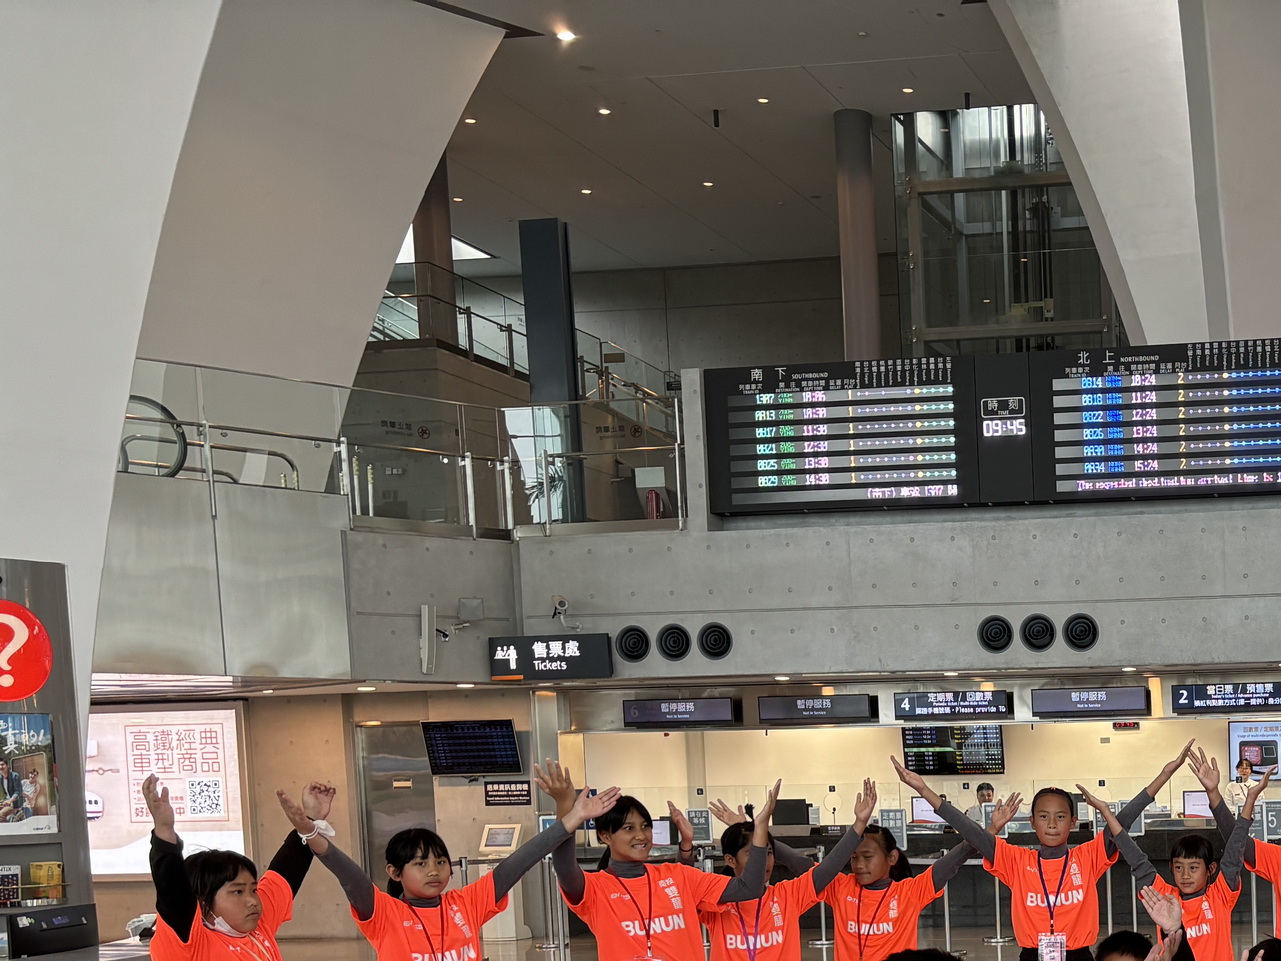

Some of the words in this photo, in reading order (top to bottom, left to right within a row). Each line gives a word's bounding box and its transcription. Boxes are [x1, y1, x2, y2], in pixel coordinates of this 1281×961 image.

[791, 372, 829, 380] SOUTHBOUND
[1130, 374, 1156, 386] 10:24
[1177, 373, 1185, 383] 2
[1131, 391, 1157, 404] 11:24
[1178, 390, 1185, 401] 2
[987, 399, 1018, 410] 時刻
[1132, 408, 1157, 420] 12:24
[1178, 407, 1186, 418] 2
[983, 419, 1026, 436] 09:45
[1132, 425, 1158, 437] 13:24
[1179, 424, 1186, 435] 2
[1179, 441, 1186, 452] 2
[805, 457, 828, 468] 13:30
[1180, 458, 1186, 469] 2
[805, 473, 829, 485] 14:30
[532, 640, 581, 659] 售票處
[533, 660, 568, 671] Tickets
[1206, 684, 1234, 695] 當日票
[1246, 683, 1274, 694] 預售票
[928, 692, 954, 702] 定期票
[966, 691, 993, 701] 回數票
[1071, 691, 1107, 702] 暫停服務
[1178, 689, 1189, 704] 2
[661, 702, 695, 712] 暫停服務
[796, 699, 832, 709] 暫停服務
[901, 697, 910, 711] 4
[130, 728, 220, 752] 高鐵經典
[131, 751, 221, 775] 車型商品
[1268, 812, 1277, 828] 5
[1026, 888, 1084, 907] BUNUN
[621, 913, 686, 936] BUNUN
[847, 920, 894, 936] BUNUN
[1186, 923, 1212, 939] NUN
[726, 929, 783, 950] BUNUN
